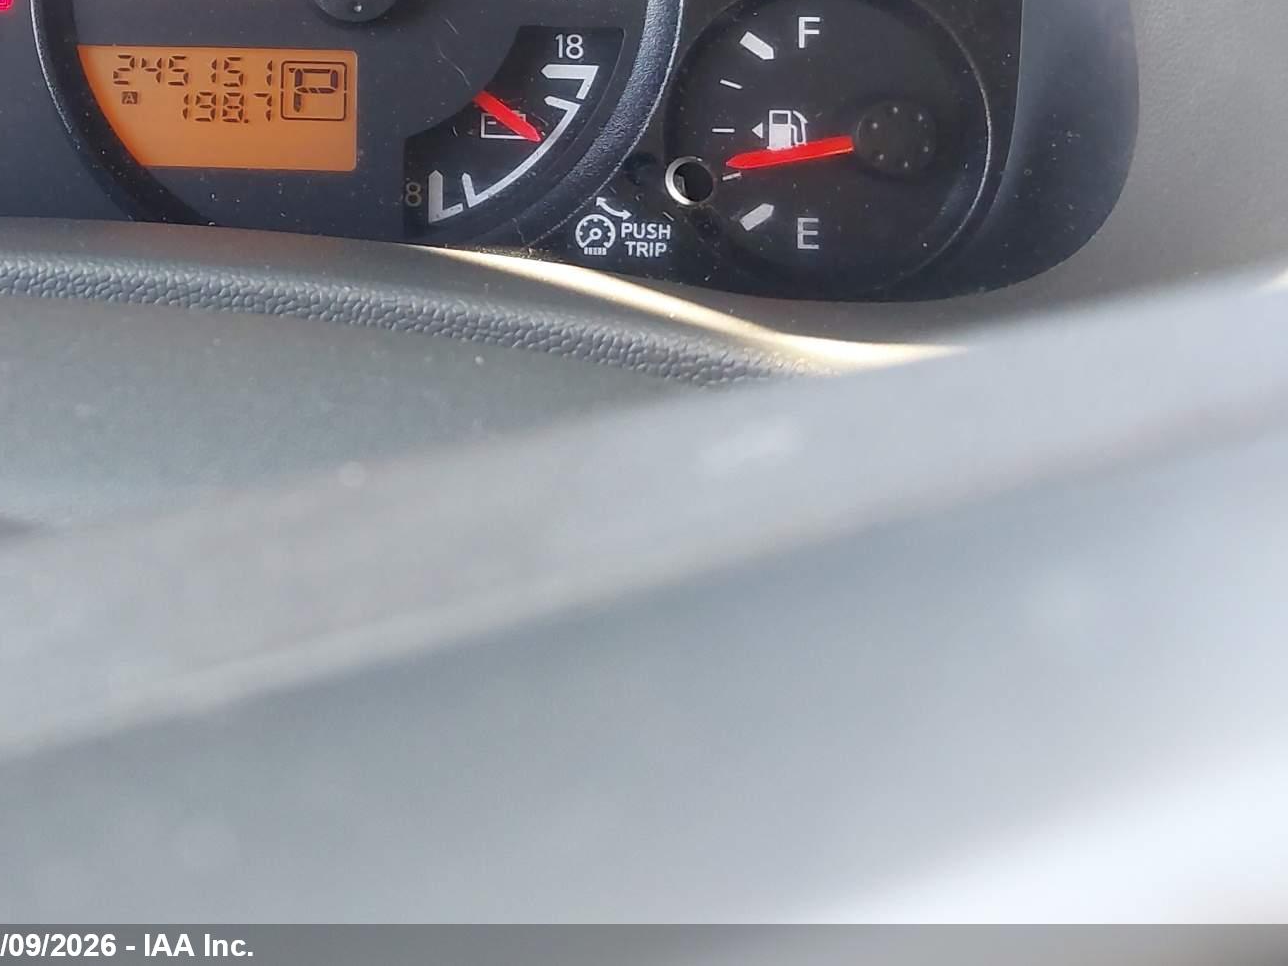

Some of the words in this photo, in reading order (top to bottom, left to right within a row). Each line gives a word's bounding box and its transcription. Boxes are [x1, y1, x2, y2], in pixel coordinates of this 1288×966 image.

[555, 34, 584, 60] 18
[798, 16, 821, 49] F
[113, 54, 273, 87] 245151
[182, 91, 273, 124] 198.7
[404, 181, 422, 207] 8
[620, 222, 671, 241] PUSH
[797, 217, 820, 250] E
[624, 241, 667, 259] TRIP
